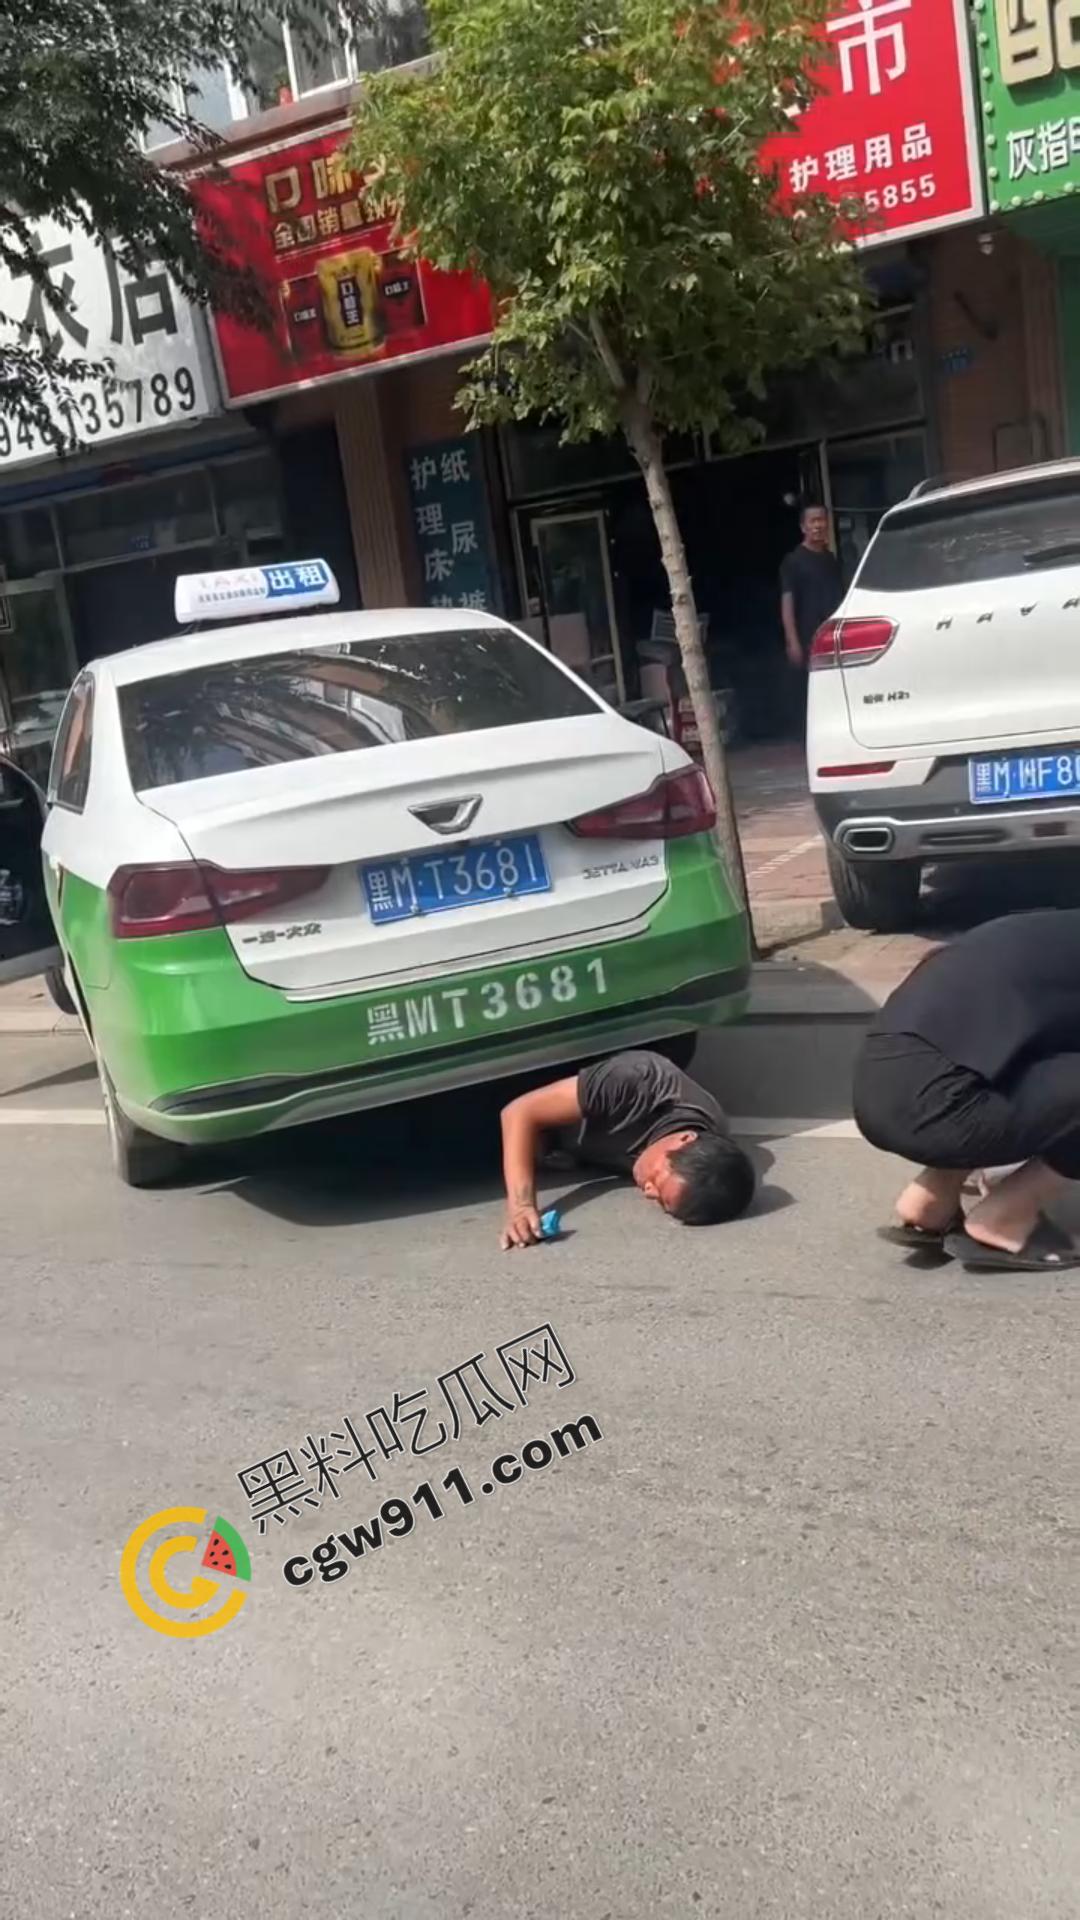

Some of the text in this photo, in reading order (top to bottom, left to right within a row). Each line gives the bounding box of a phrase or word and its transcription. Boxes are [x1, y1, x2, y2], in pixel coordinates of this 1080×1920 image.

[788, 122, 933, 193] 护理用品
[267, 564, 326, 591] 出租
[367, 957, 608, 1046] 黑MT3681
